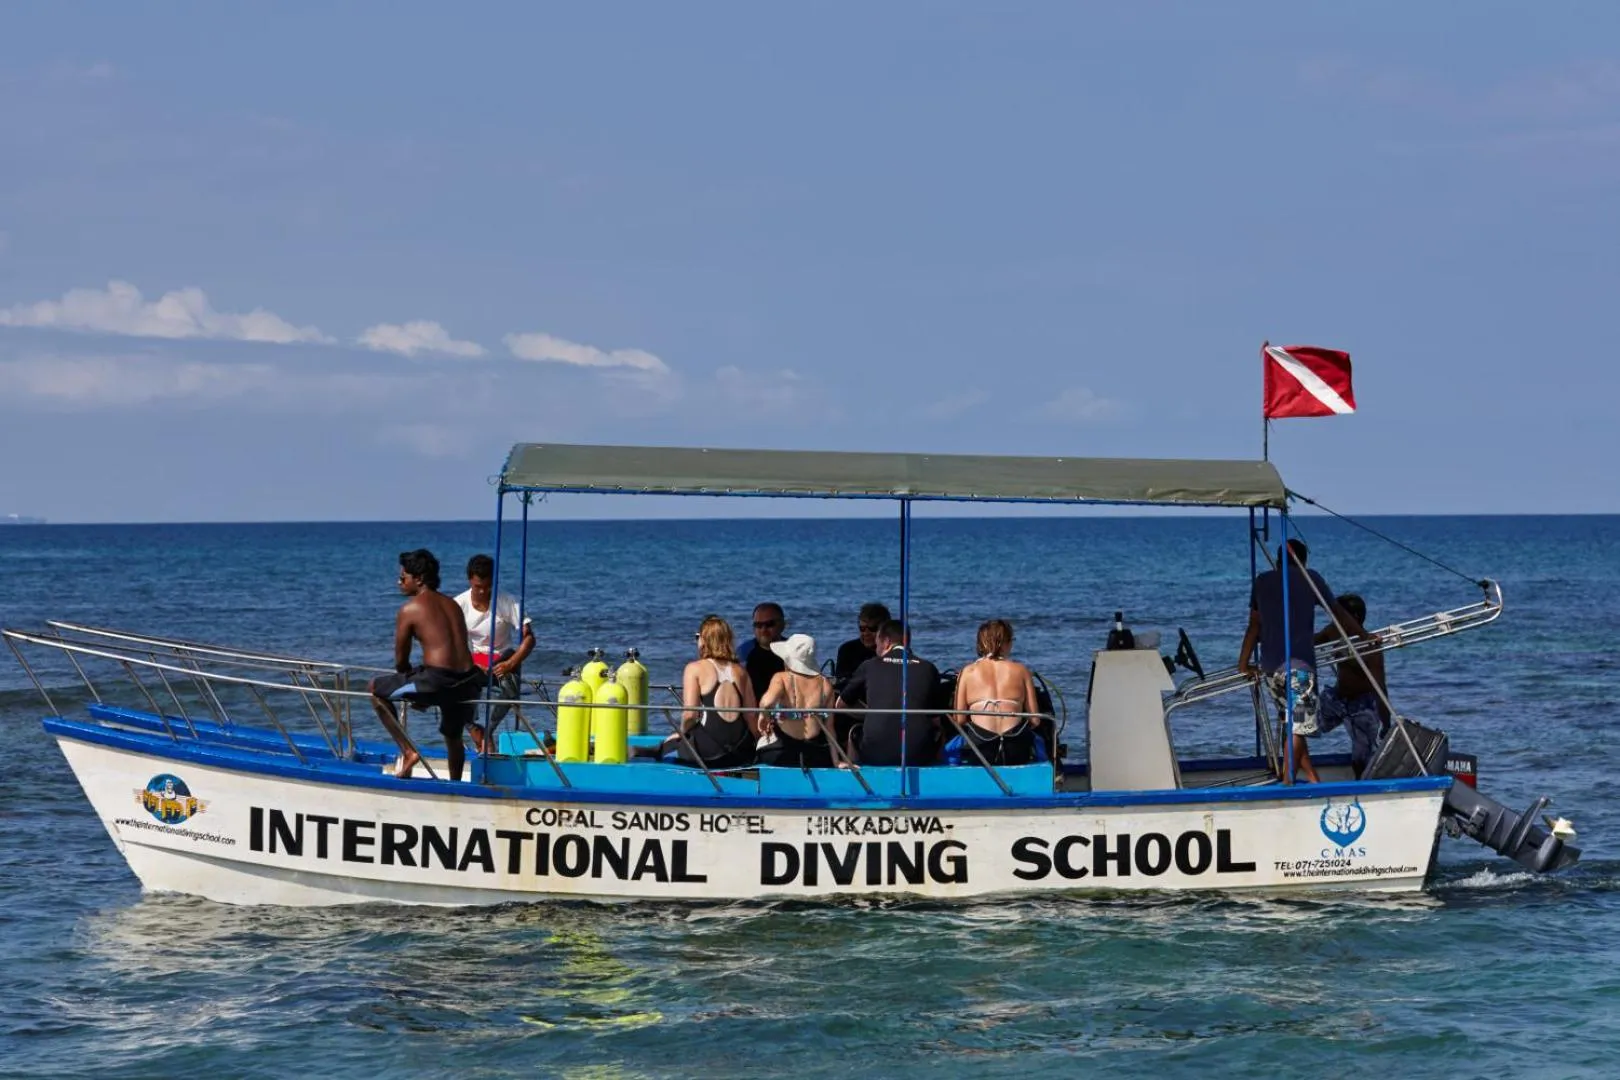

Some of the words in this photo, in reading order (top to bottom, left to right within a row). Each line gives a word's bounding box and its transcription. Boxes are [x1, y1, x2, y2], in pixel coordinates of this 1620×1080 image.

[1445, 760, 1471, 772] MAHA
[525, 807, 603, 829] CORAL
[611, 811, 690, 832] SANDS
[248, 806, 708, 883] INTERNATIONAL
[760, 839, 969, 887] DIVING
[1011, 828, 1257, 881] SCHOOL
[1283, 865, 1418, 878] www.theinternationaldivingschool.com
